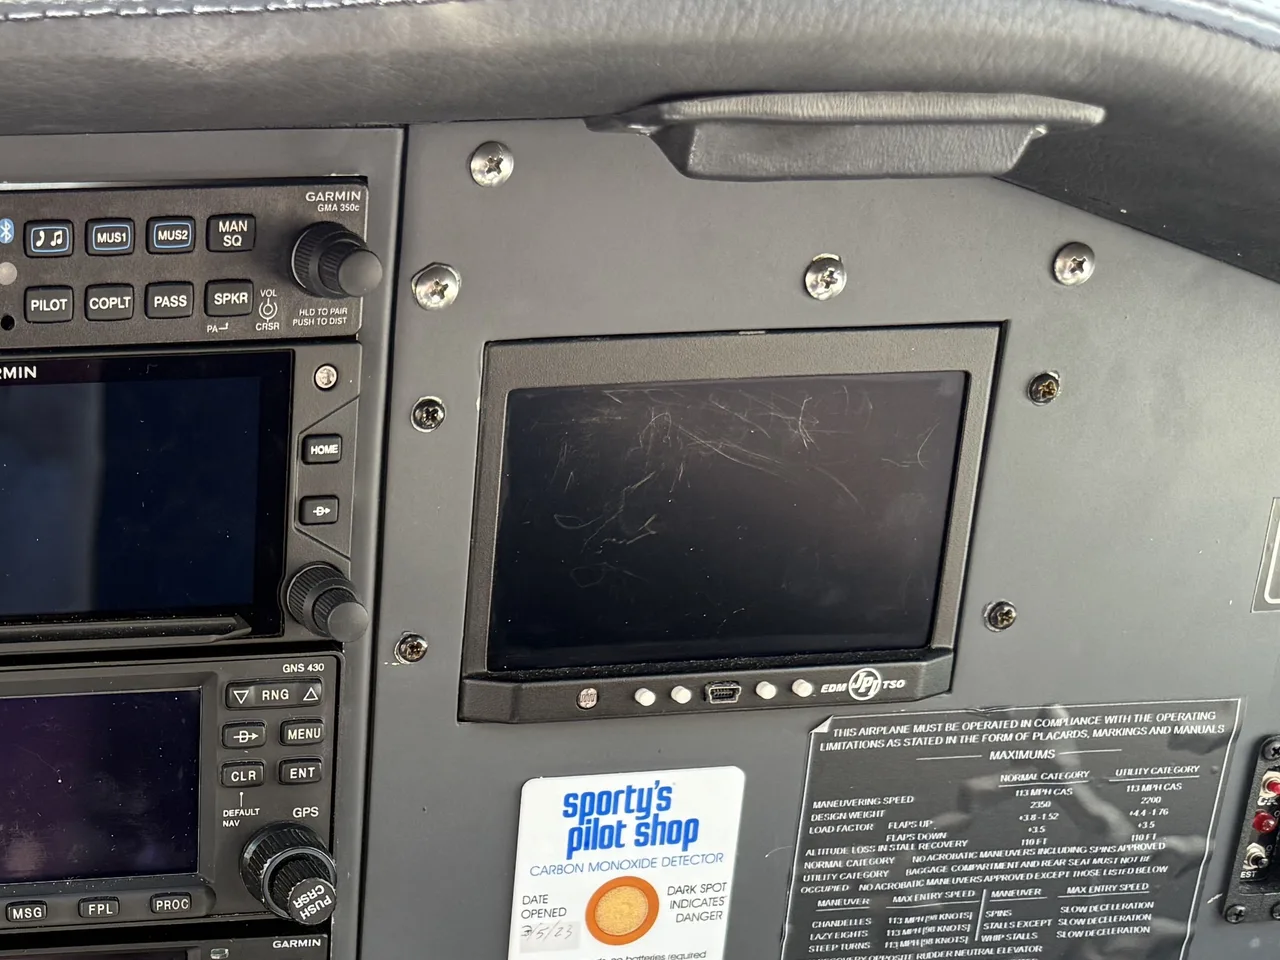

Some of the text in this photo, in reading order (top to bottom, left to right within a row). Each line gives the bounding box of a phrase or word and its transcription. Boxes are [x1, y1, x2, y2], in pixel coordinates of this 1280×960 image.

[306, 191, 361, 202] GARMIN
[317, 203, 338, 212] GMA
[219, 221, 248, 233] MAN
[97, 232, 126, 243] MUS1
[223, 234, 242, 248] SQ
[89, 296, 131, 310] COPLT
[154, 295, 188, 308] PASS
[214, 292, 248, 305] SPKR
[31, 299, 67, 312] PILOT
[299, 308, 316, 316] HLD
[318, 308, 328, 316] TO
[292, 318, 315, 326] PUSH
[329, 317, 347, 325] DIST
[310, 444, 339, 455] HOME
[282, 663, 325, 673] GNS 430
[821, 683, 846, 693] EDM
[882, 679, 905, 689] TSO
[262, 689, 289, 701] RNG
[287, 728, 321, 740] MENU
[833, 721, 1018, 737] THIS AIRPLANE MUST BE OPERATED
[989, 749, 1056, 761] MAXIMUMS
[231, 770, 256, 782] CLR
[290, 768, 314, 778] ENT
[563, 780, 673, 825] sporty's
[223, 808, 260, 817] DEFAULT
[292, 807, 319, 818] GPS
[566, 813, 699, 860] pilot shop
[530, 853, 723, 876] CARBON MONOXIDE DETECTOR
[667, 882, 726, 895] DARK SPOT
[156, 899, 188, 910] PROC
[522, 894, 548, 905] DATE
[670, 897, 725, 909] INDICATES
[13, 907, 42, 919] MSG
[521, 908, 567, 919] OPENED
[676, 911, 722, 923] DANGER
[272, 939, 321, 949] GARMIN
